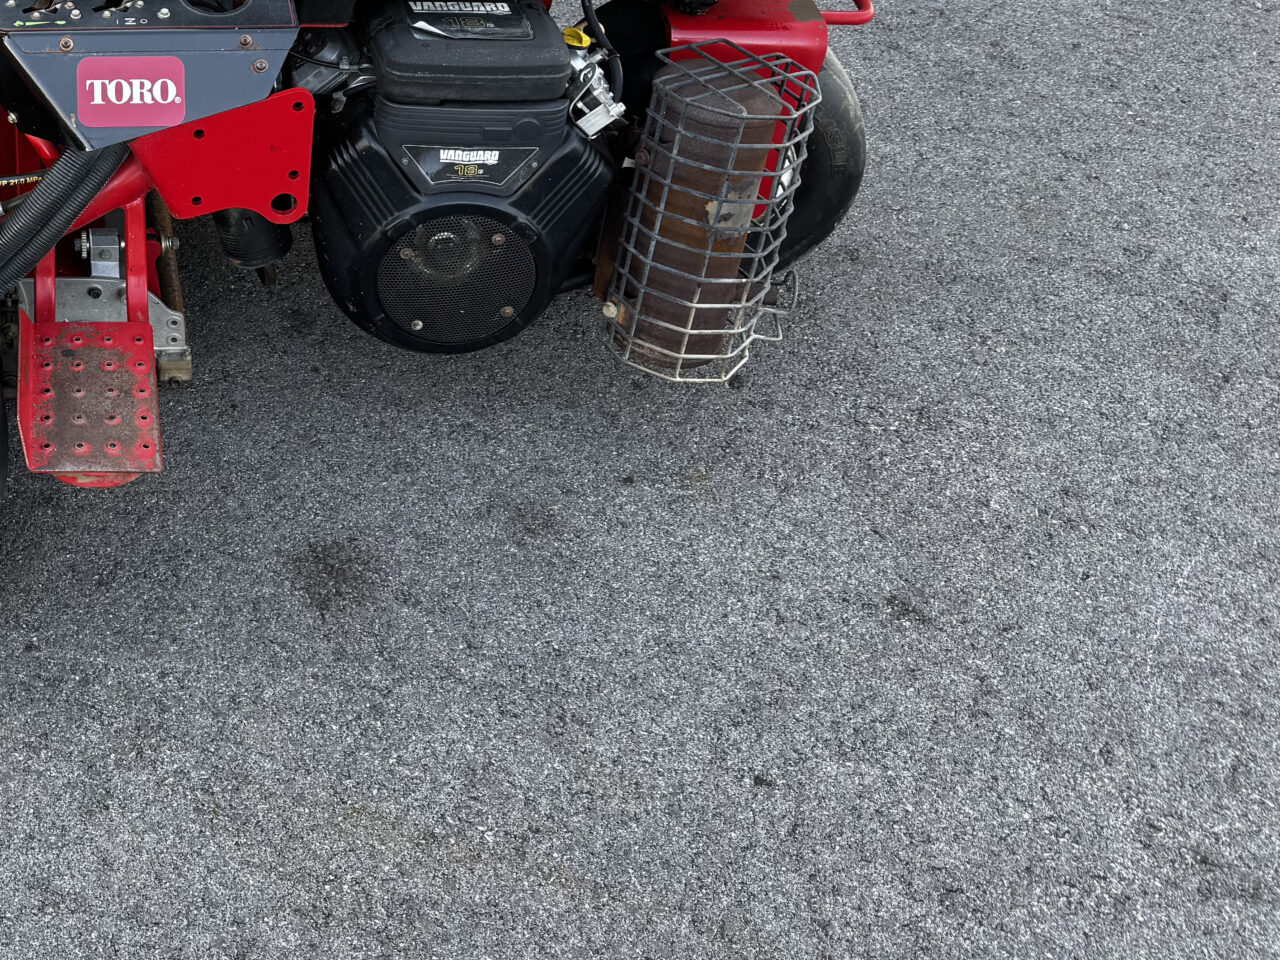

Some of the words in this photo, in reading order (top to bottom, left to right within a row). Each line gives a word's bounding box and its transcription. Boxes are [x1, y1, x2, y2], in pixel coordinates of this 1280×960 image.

[408, 1, 511, 13] VANGUARD
[85, 78, 177, 105] TORO
[439, 149, 500, 162] VANGUARD
